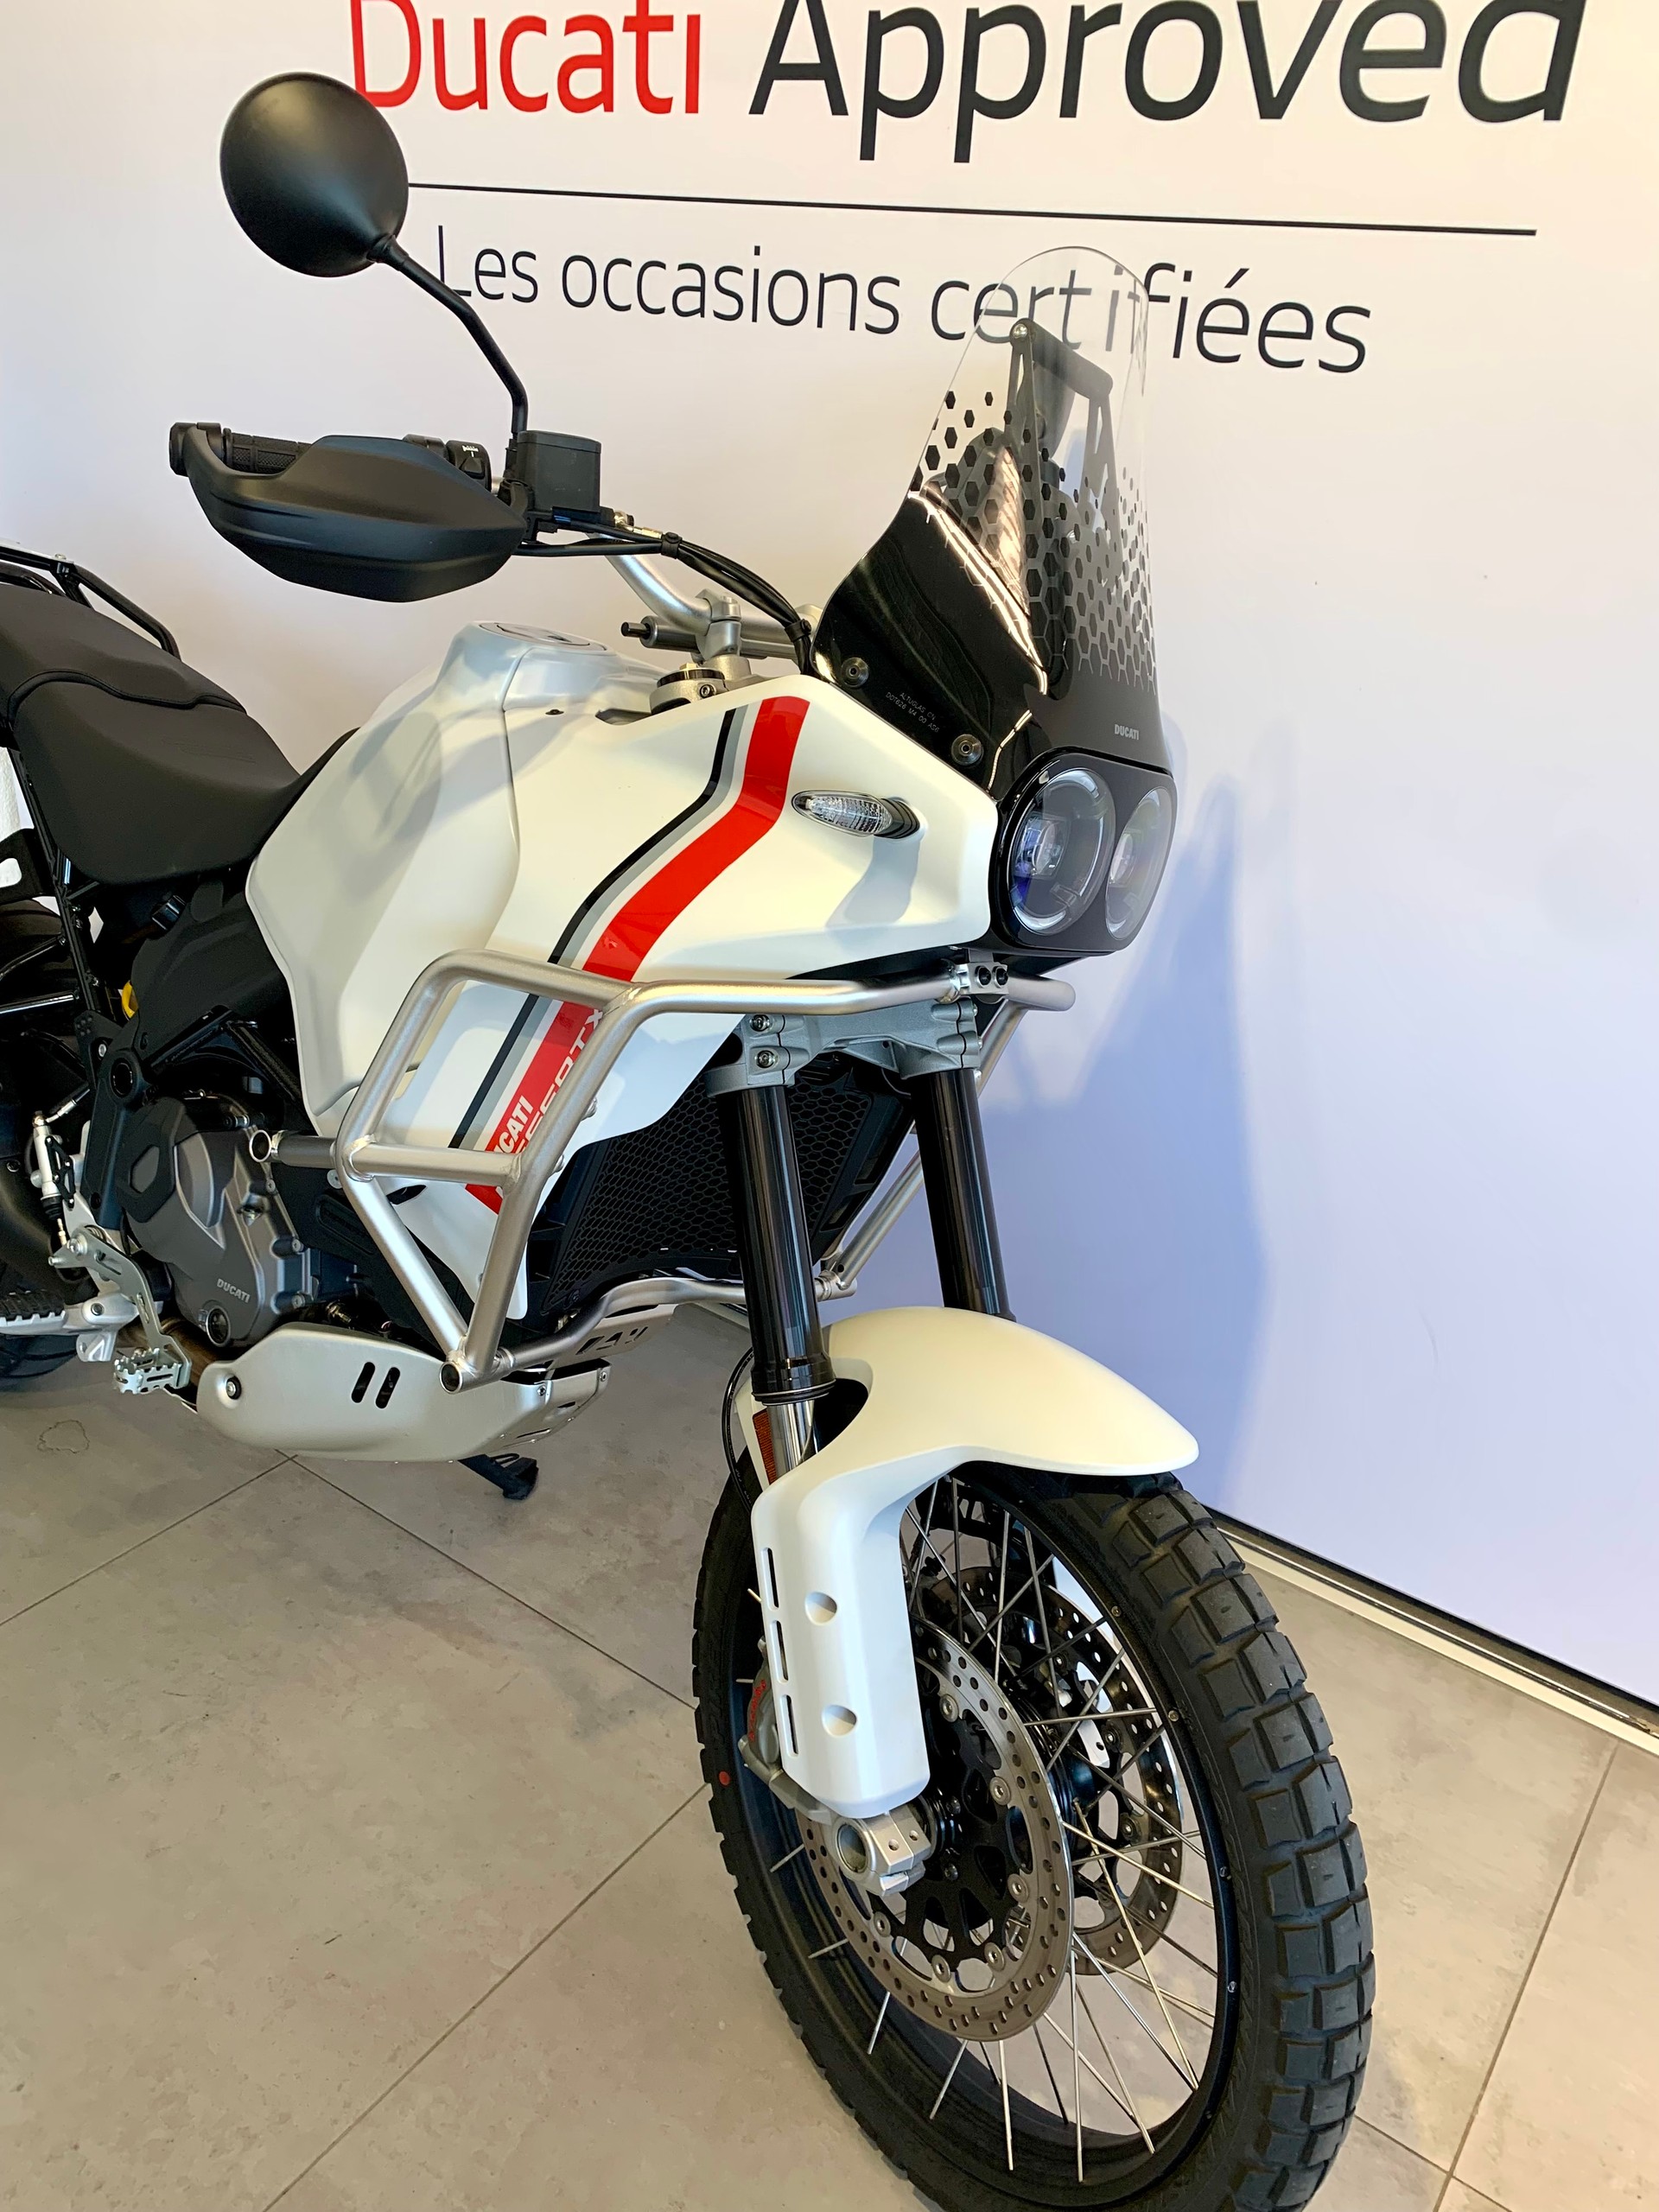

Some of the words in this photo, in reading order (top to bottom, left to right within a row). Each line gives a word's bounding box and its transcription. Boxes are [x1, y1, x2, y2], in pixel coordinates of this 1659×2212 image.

[350, 0, 701, 114] Ducati
[748, 0, 1590, 163] Approved
[437, 225, 538, 304] Les
[562, 245, 900, 335] occasions
[930, 262, 1371, 373] certifiées
[1114, 723, 1140, 741] DUCATI
[493, 1094, 534, 1154] CATI
[216, 1278, 251, 1304] DUCATI
